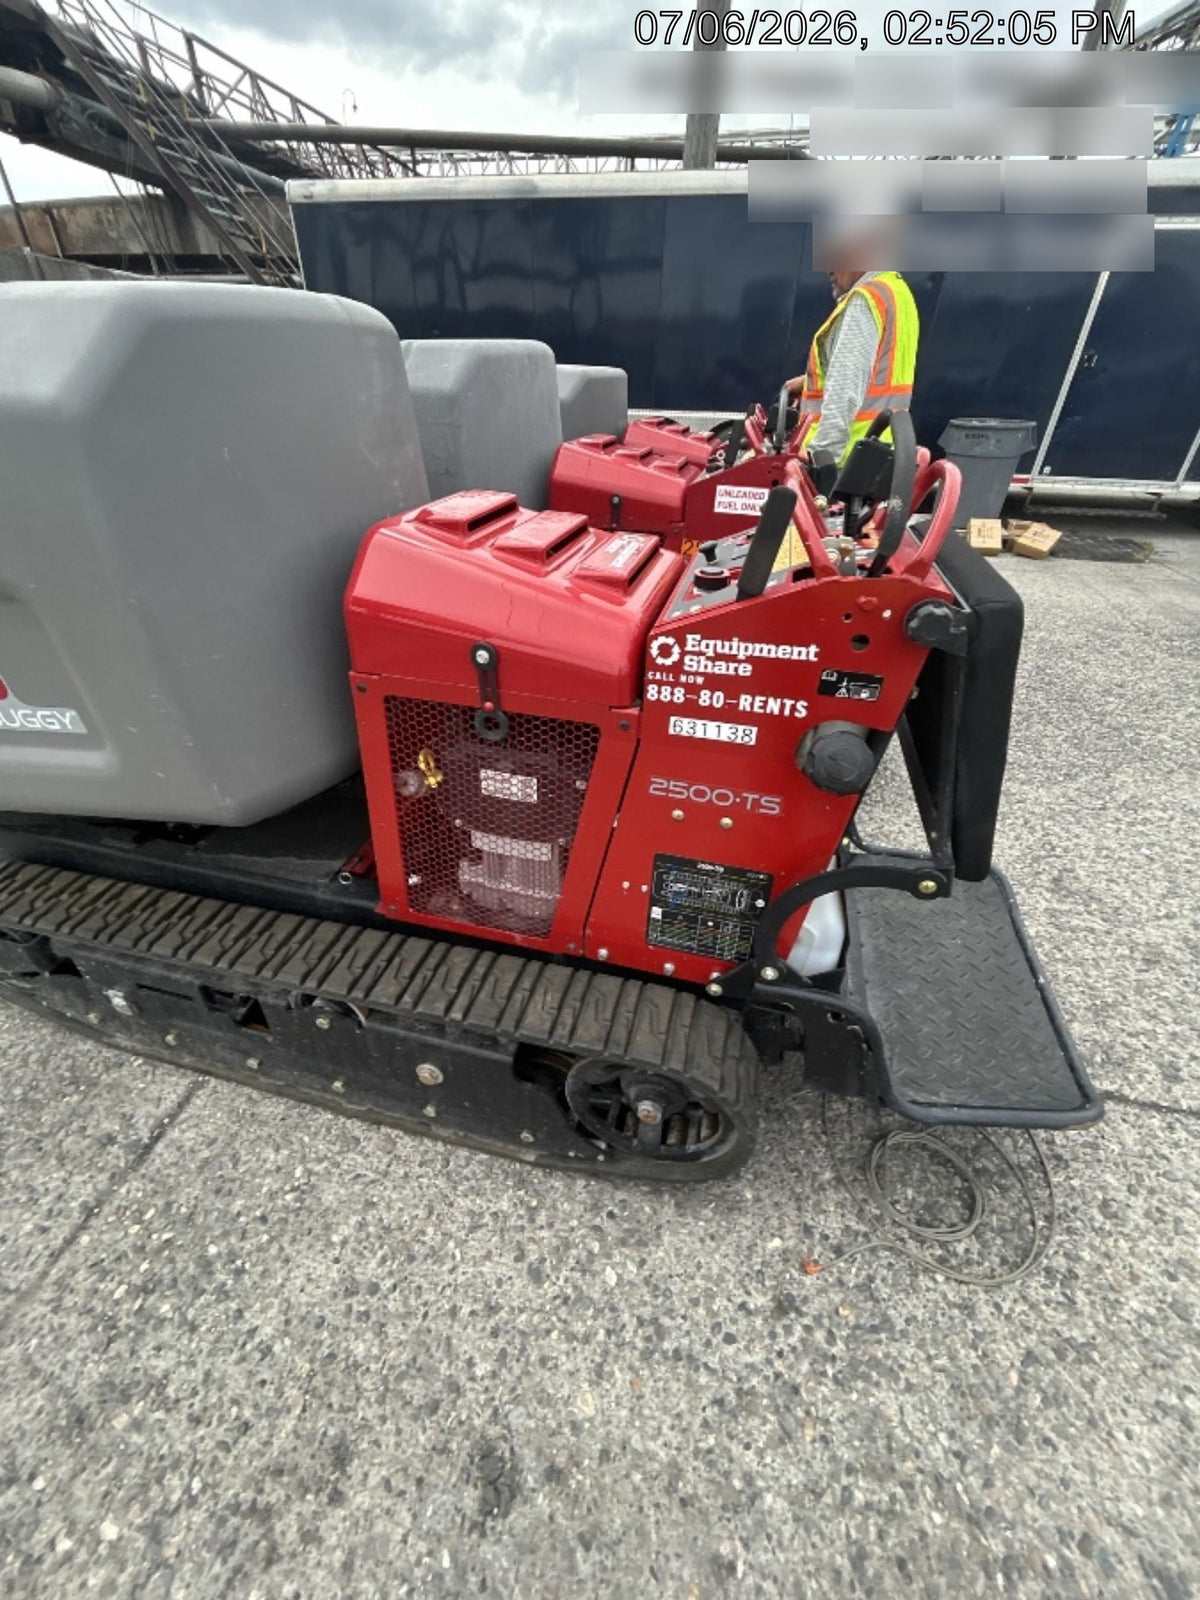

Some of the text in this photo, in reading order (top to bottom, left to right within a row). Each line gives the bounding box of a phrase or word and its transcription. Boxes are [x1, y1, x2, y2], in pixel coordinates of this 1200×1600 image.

[718, 488, 766, 500] UNLEADED
[717, 501, 738, 511] FUEL
[684, 634, 820, 661] Equipment
[683, 655, 753, 677] Share
[647, 671, 704, 685] CALL NOW
[646, 684, 809, 718] 888-80-RENTS
[672, 718, 754, 743] 631138
